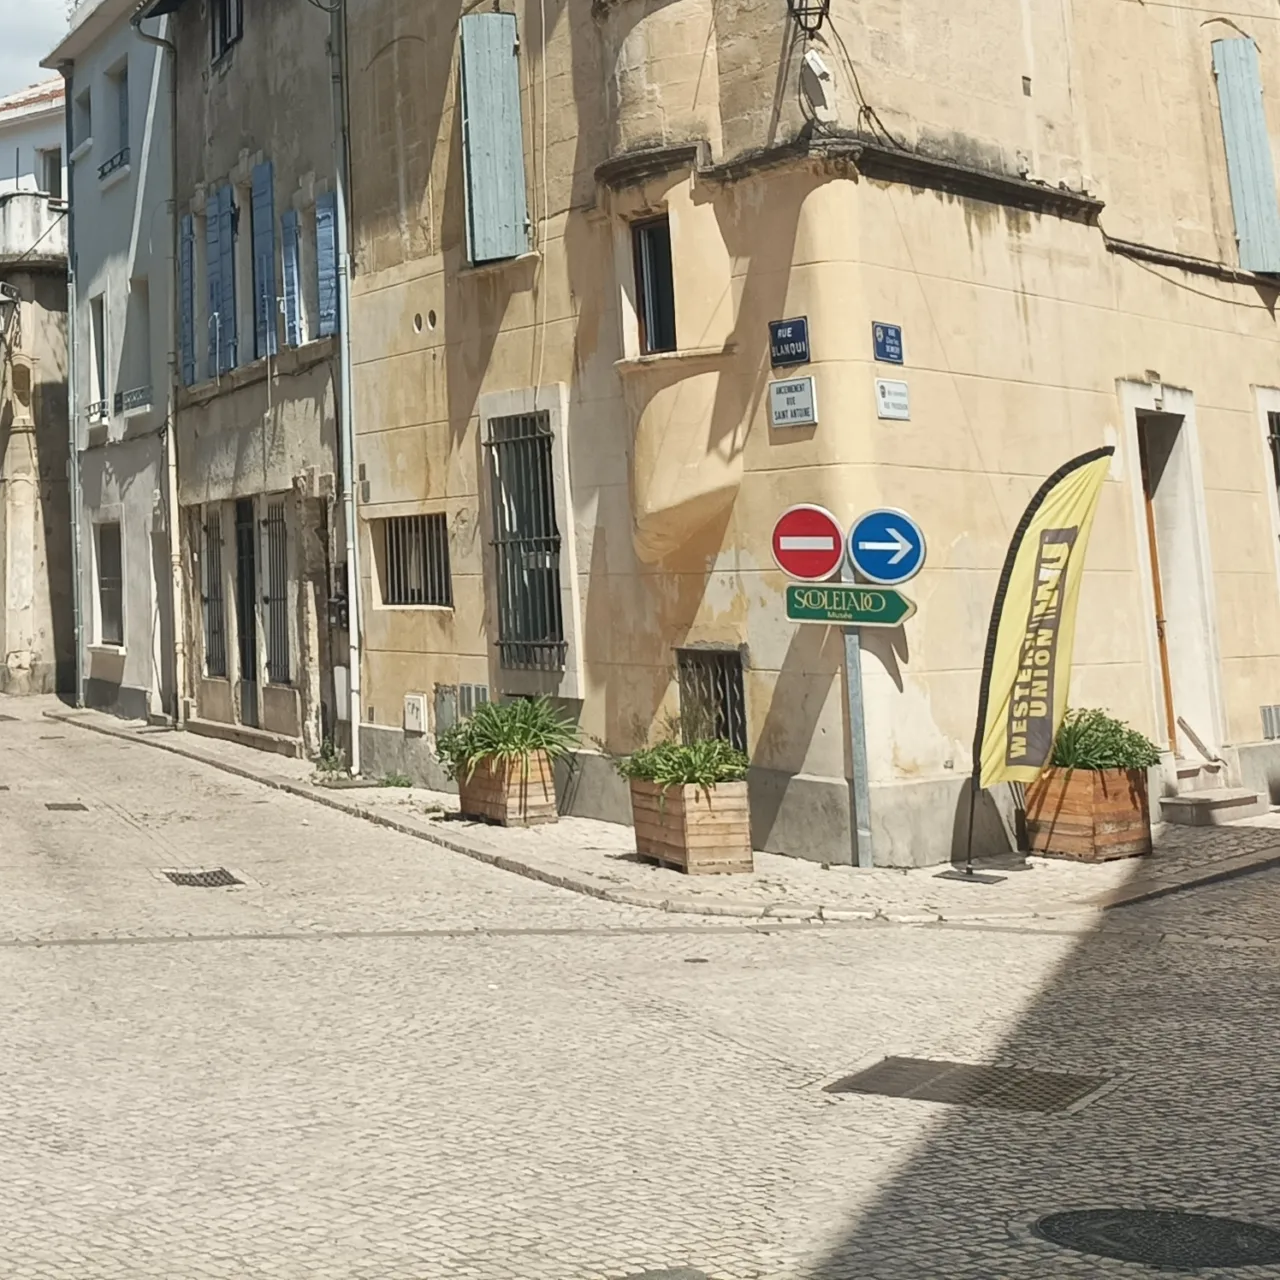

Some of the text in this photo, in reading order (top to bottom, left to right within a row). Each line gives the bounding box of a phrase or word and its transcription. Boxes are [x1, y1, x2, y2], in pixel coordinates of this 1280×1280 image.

[777, 327, 793, 339] RUE
[772, 341, 805, 357] BLANQUI
[786, 396, 796, 406] RUE
[774, 407, 810, 421] SAINT ANTOINE
[1029, 629, 1054, 718] UNION
